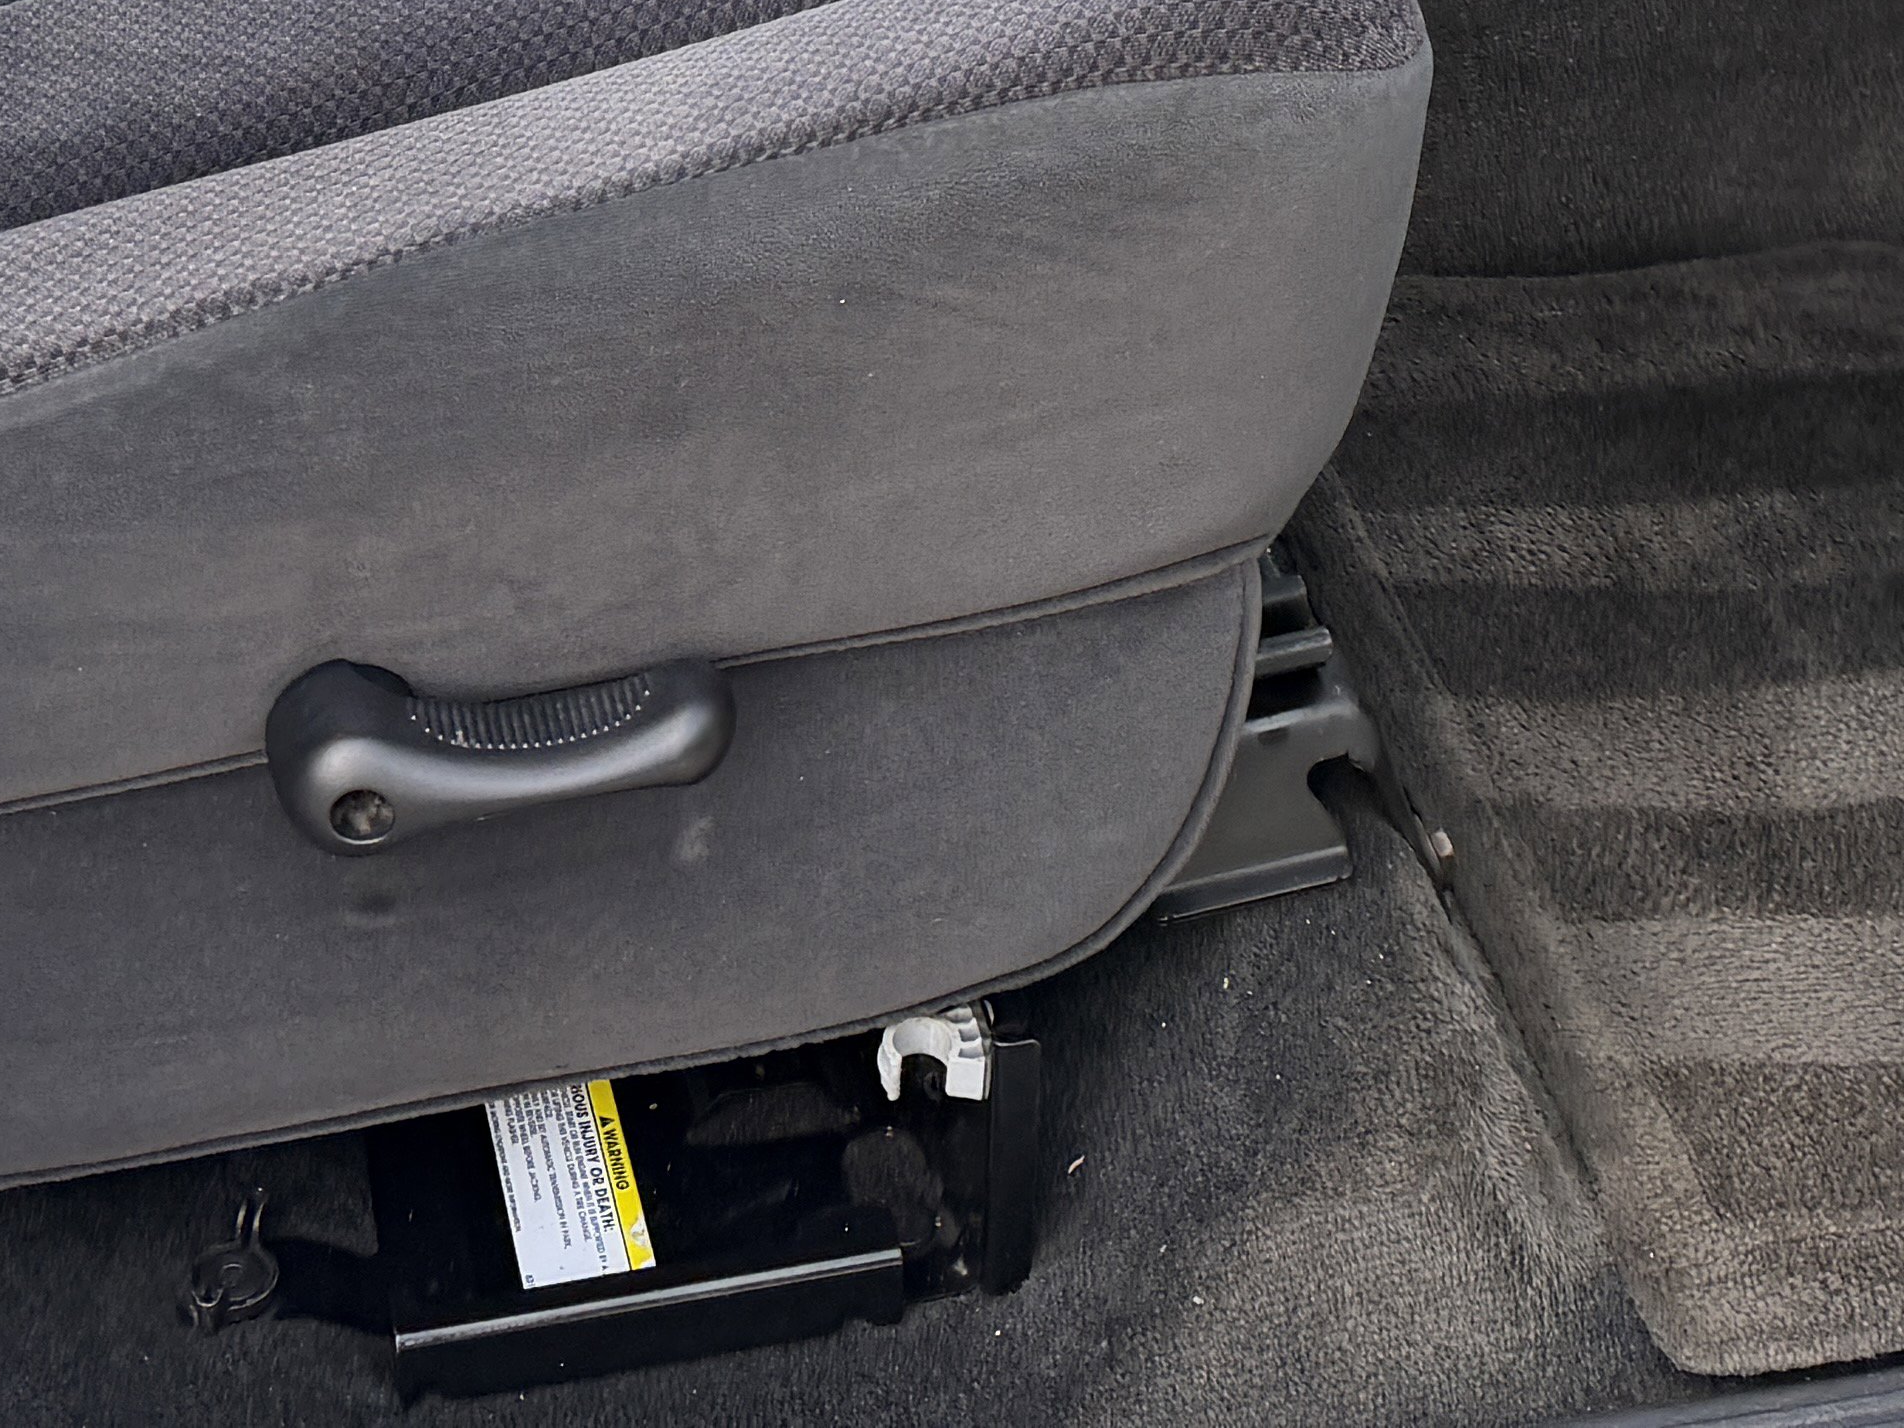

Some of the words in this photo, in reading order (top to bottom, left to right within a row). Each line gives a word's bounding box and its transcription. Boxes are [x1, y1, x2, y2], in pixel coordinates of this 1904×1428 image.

[578, 1120, 600, 1164] INJURY
[602, 1128, 630, 1192] WARNING
[589, 1166, 605, 1186] OR
[594, 1188, 616, 1232] DEATH:
